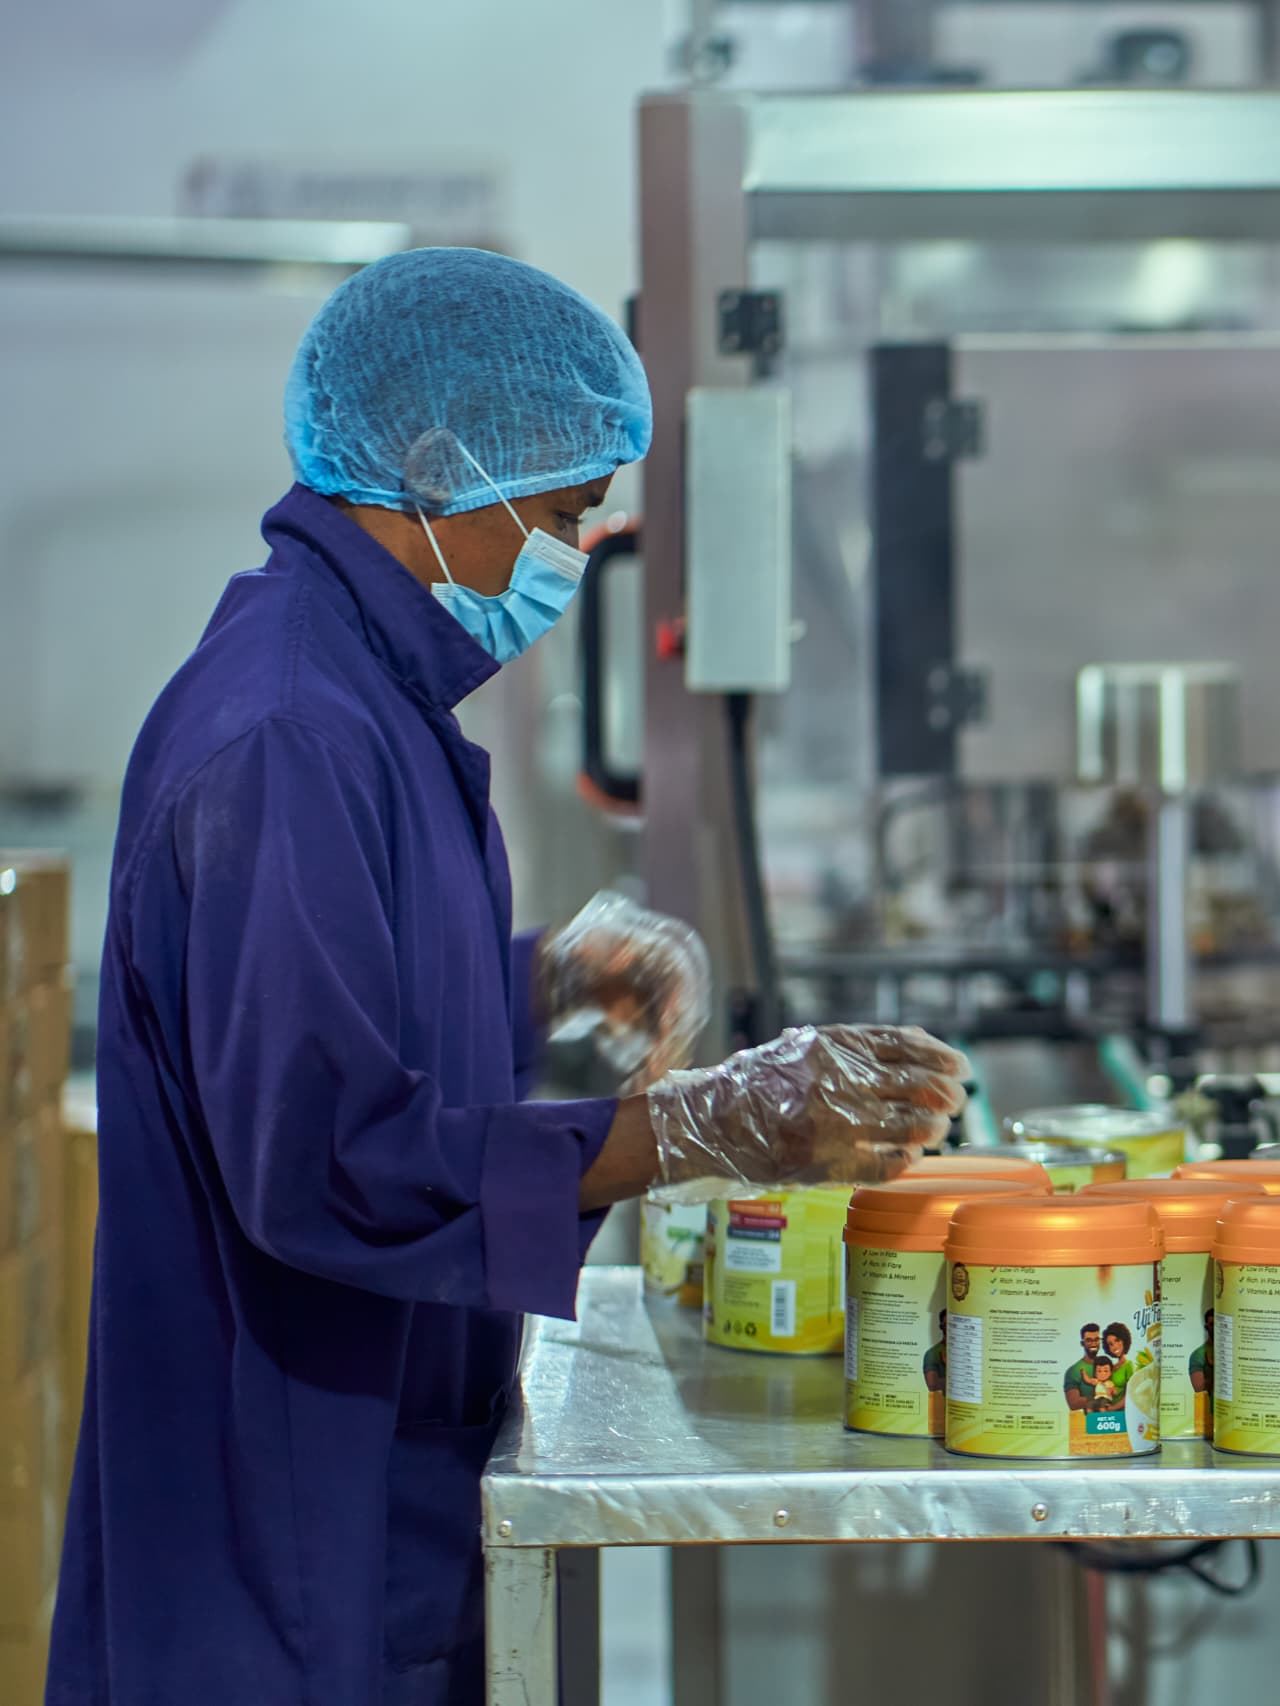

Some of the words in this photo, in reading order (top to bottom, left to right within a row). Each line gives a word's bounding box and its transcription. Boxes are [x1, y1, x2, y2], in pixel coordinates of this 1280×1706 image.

[1133, 1307, 1151, 1338] Uji
[1151, 1303, 1161, 1323] Fa
[1096, 1421, 1121, 1431] 600g
